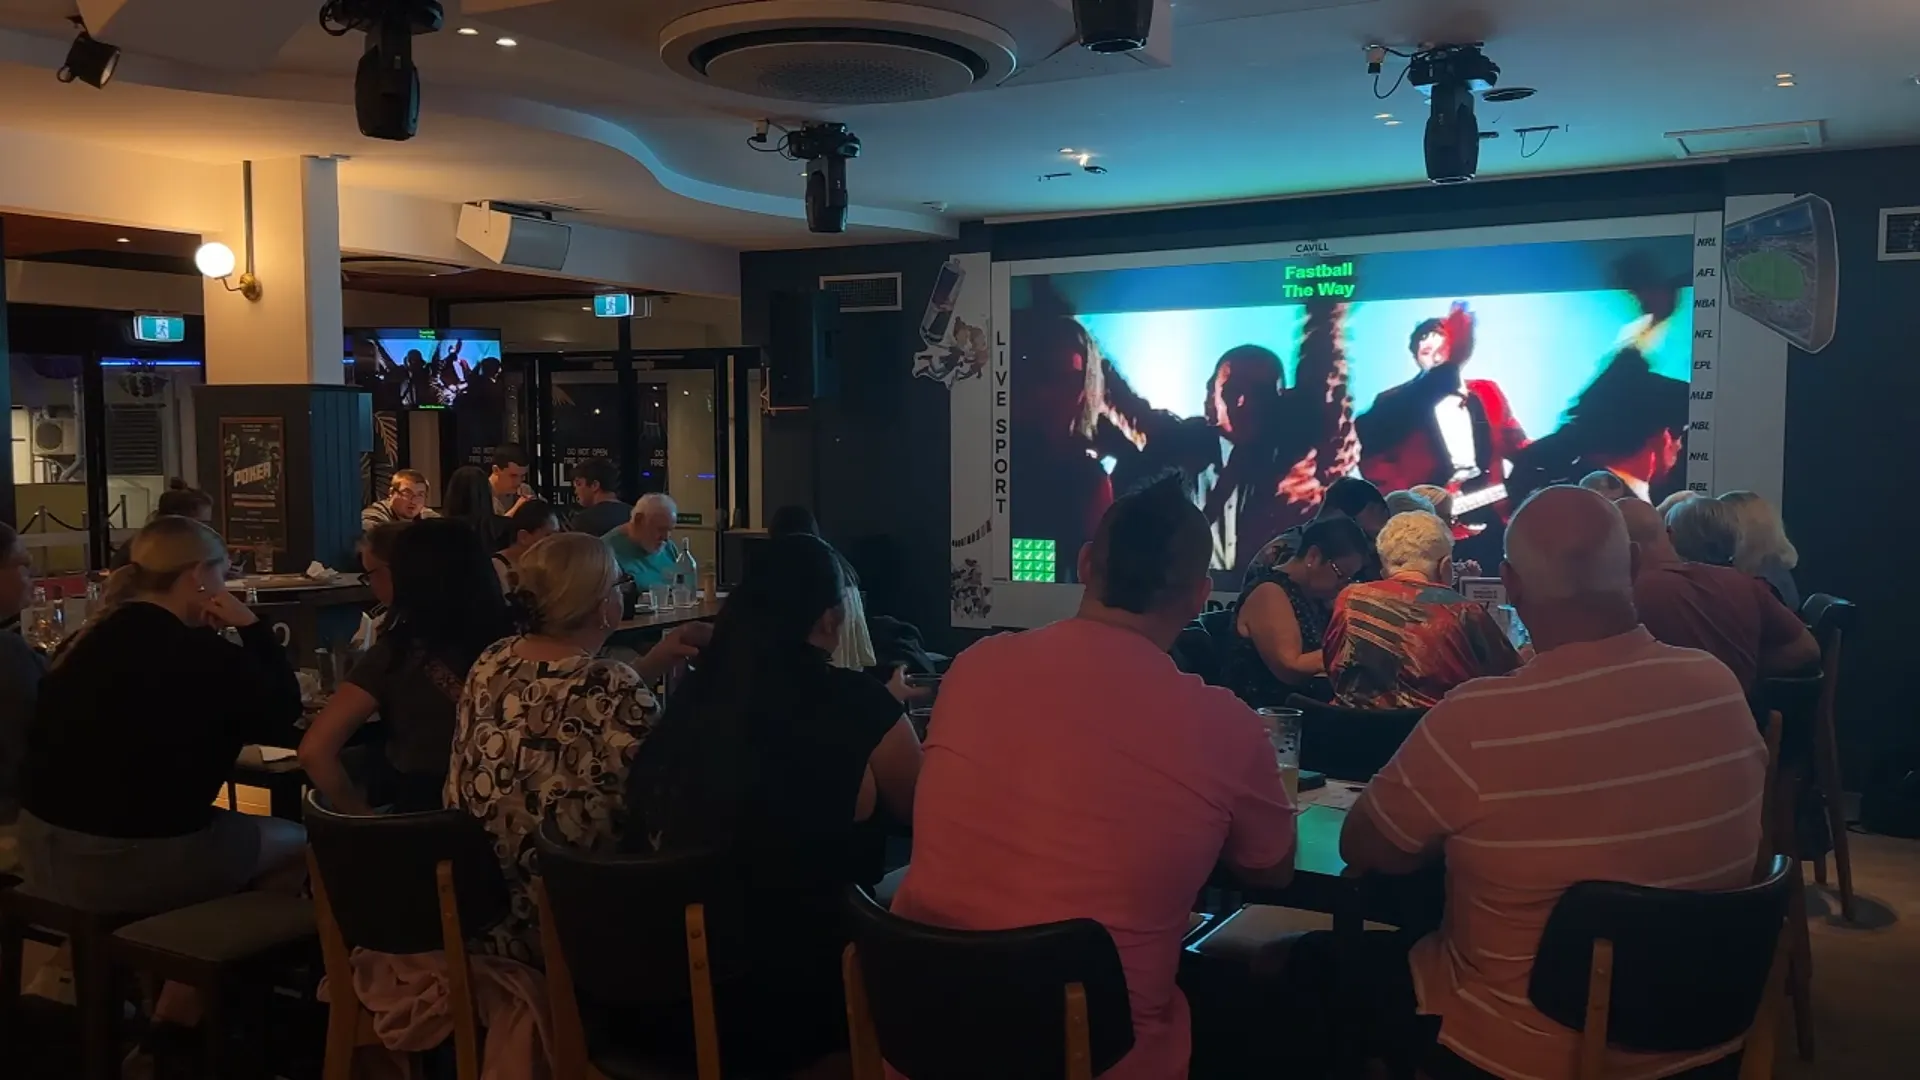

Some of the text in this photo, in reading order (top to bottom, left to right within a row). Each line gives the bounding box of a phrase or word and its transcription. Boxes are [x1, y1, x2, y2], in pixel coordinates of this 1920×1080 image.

[1697, 237, 1716, 247] NRL
[1295, 242, 1329, 253] CAVILL
[1284, 262, 1353, 280] Fastball
[1696, 268, 1716, 277] AFL
[1282, 281, 1356, 298] The Way
[1694, 298, 1716, 308] NBA
[1695, 330, 1713, 338] NFL
[1693, 360, 1712, 370] EPL
[1690, 391, 1713, 400] MLB
[994, 331, 1009, 514] LIVE SPORT
[1690, 421, 1710, 430] NBL
[1689, 452, 1709, 461] NHL
[650, 458, 665, 467] FIRE
[233, 461, 272, 488] POKER
